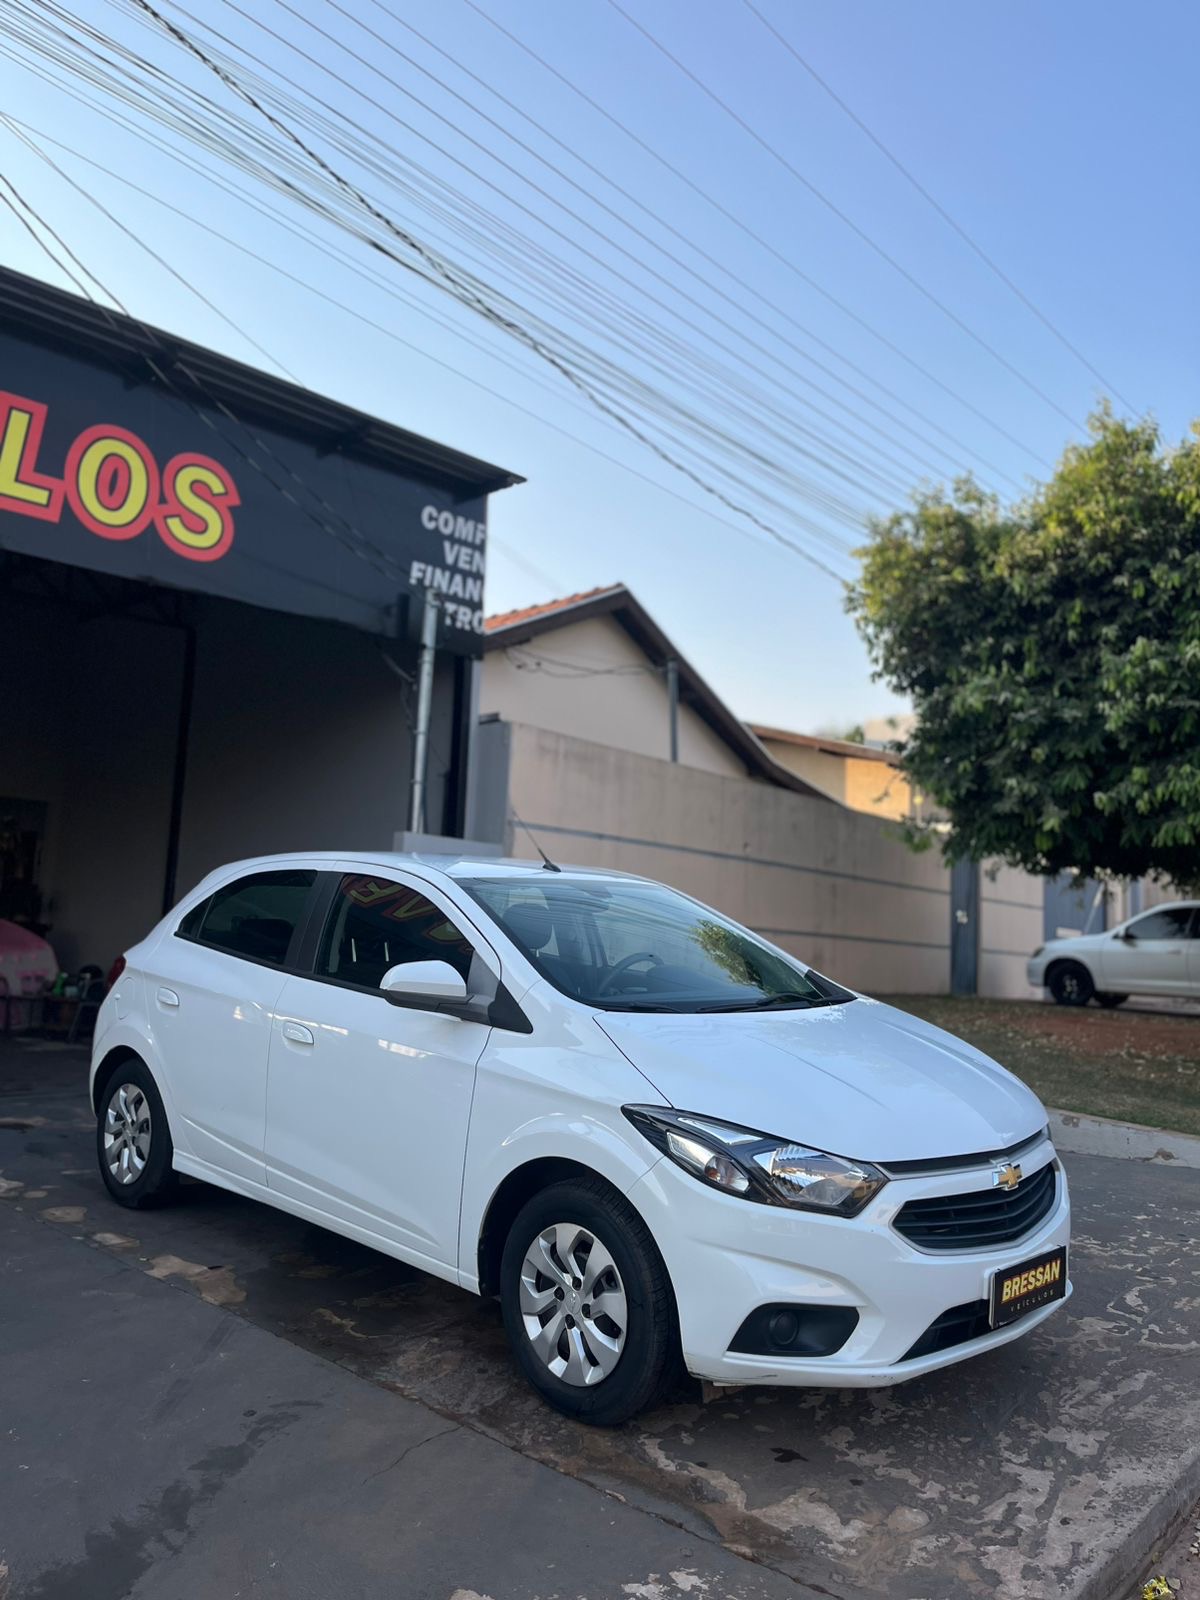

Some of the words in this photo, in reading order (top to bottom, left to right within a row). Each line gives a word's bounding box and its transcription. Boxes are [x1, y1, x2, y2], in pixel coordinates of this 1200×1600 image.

[0, 389, 241, 562] LOS
[409, 560, 482, 603] FINAN
[1001, 1259, 1061, 1304] BRESSAN
